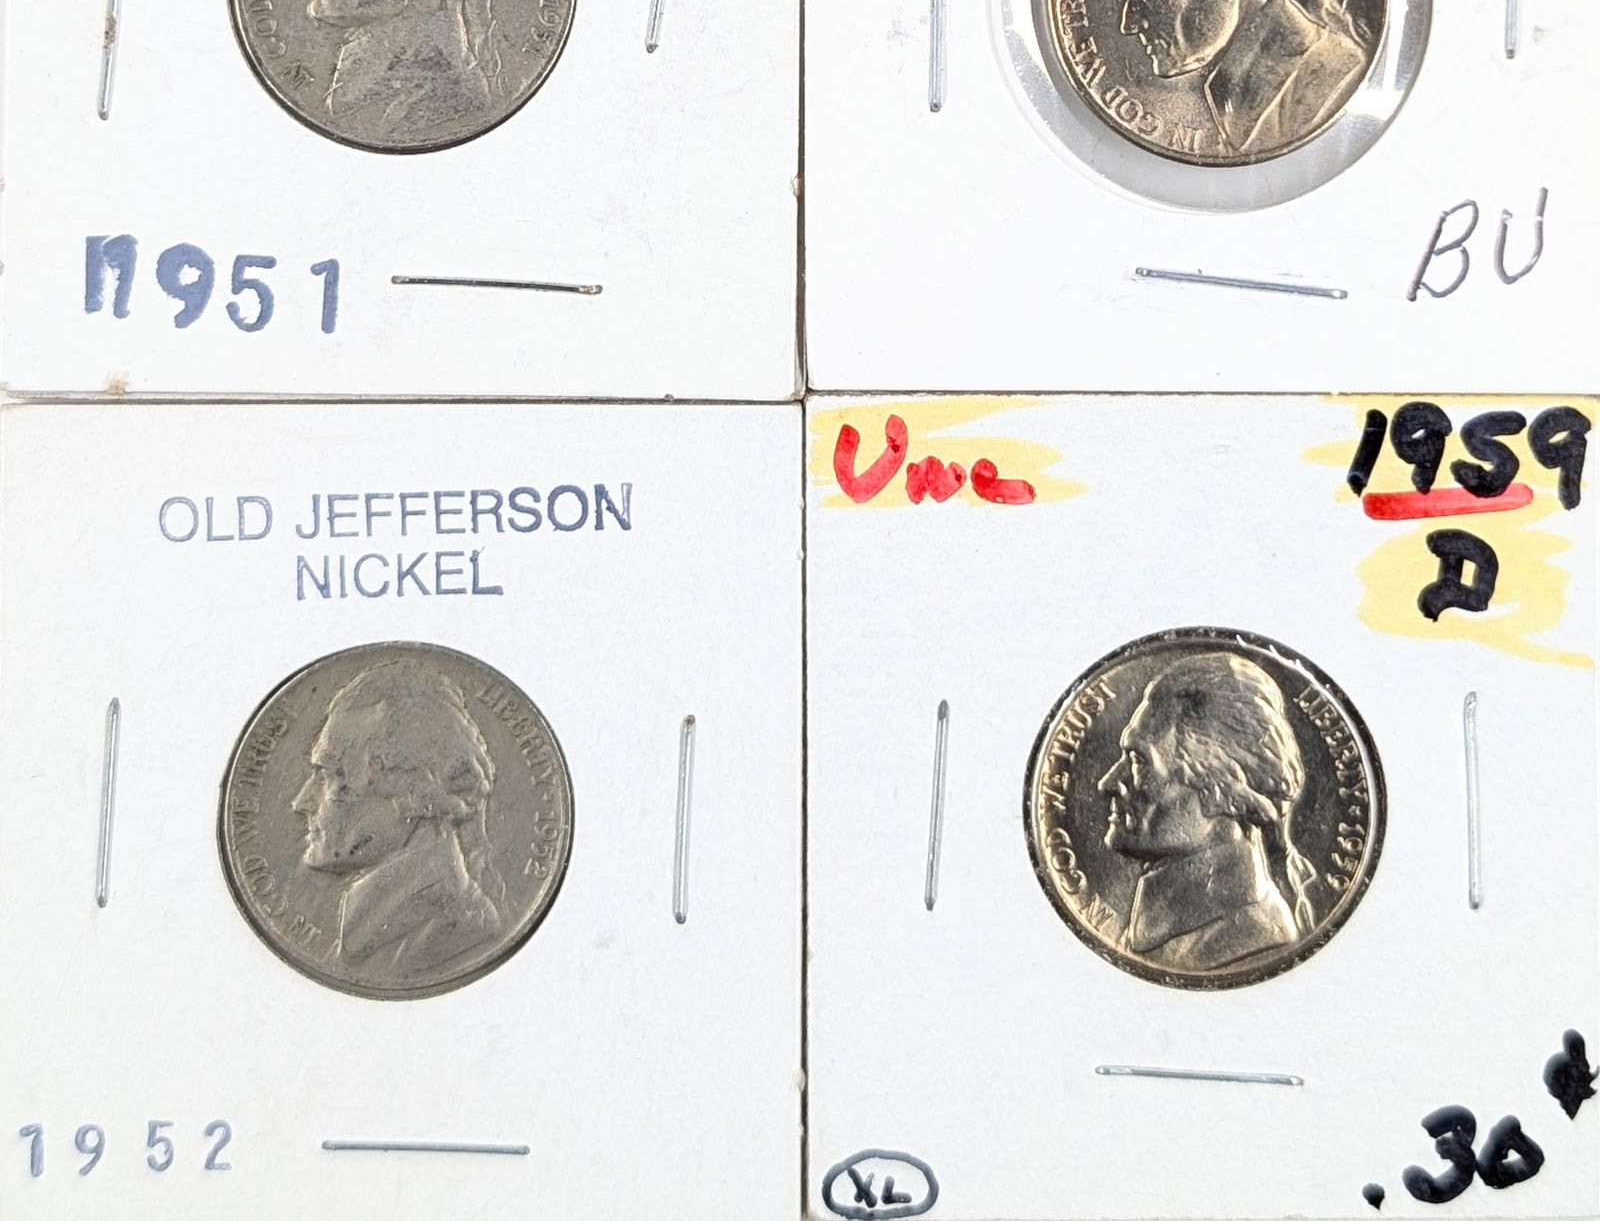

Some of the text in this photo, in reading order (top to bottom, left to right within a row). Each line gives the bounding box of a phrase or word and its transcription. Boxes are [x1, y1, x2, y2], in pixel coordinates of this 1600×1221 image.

[1068, 36, 1106, 85] WE
[1102, 85, 1163, 139] GOD
[1169, 121, 1203, 154] IN
[1406, 187, 1548, 302] BU
[85, 235, 340, 334] 1951
[1347, 401, 1592, 511] 1959
[159, 482, 633, 543] OLD JEFFERSON
[296, 547, 504, 601] NICKEL
[1418, 528, 1499, 622] D
[476, 682, 559, 880] LIBERTY 1952
[1041, 675, 1118, 931] IN GOD WE TRUST
[1293, 684, 1369, 891] LIBERTY 1959
[233, 798, 260, 843] WE
[244, 854, 289, 916] GOD
[287, 914, 322, 945] IN
[18, 1120, 233, 1177] 1952
